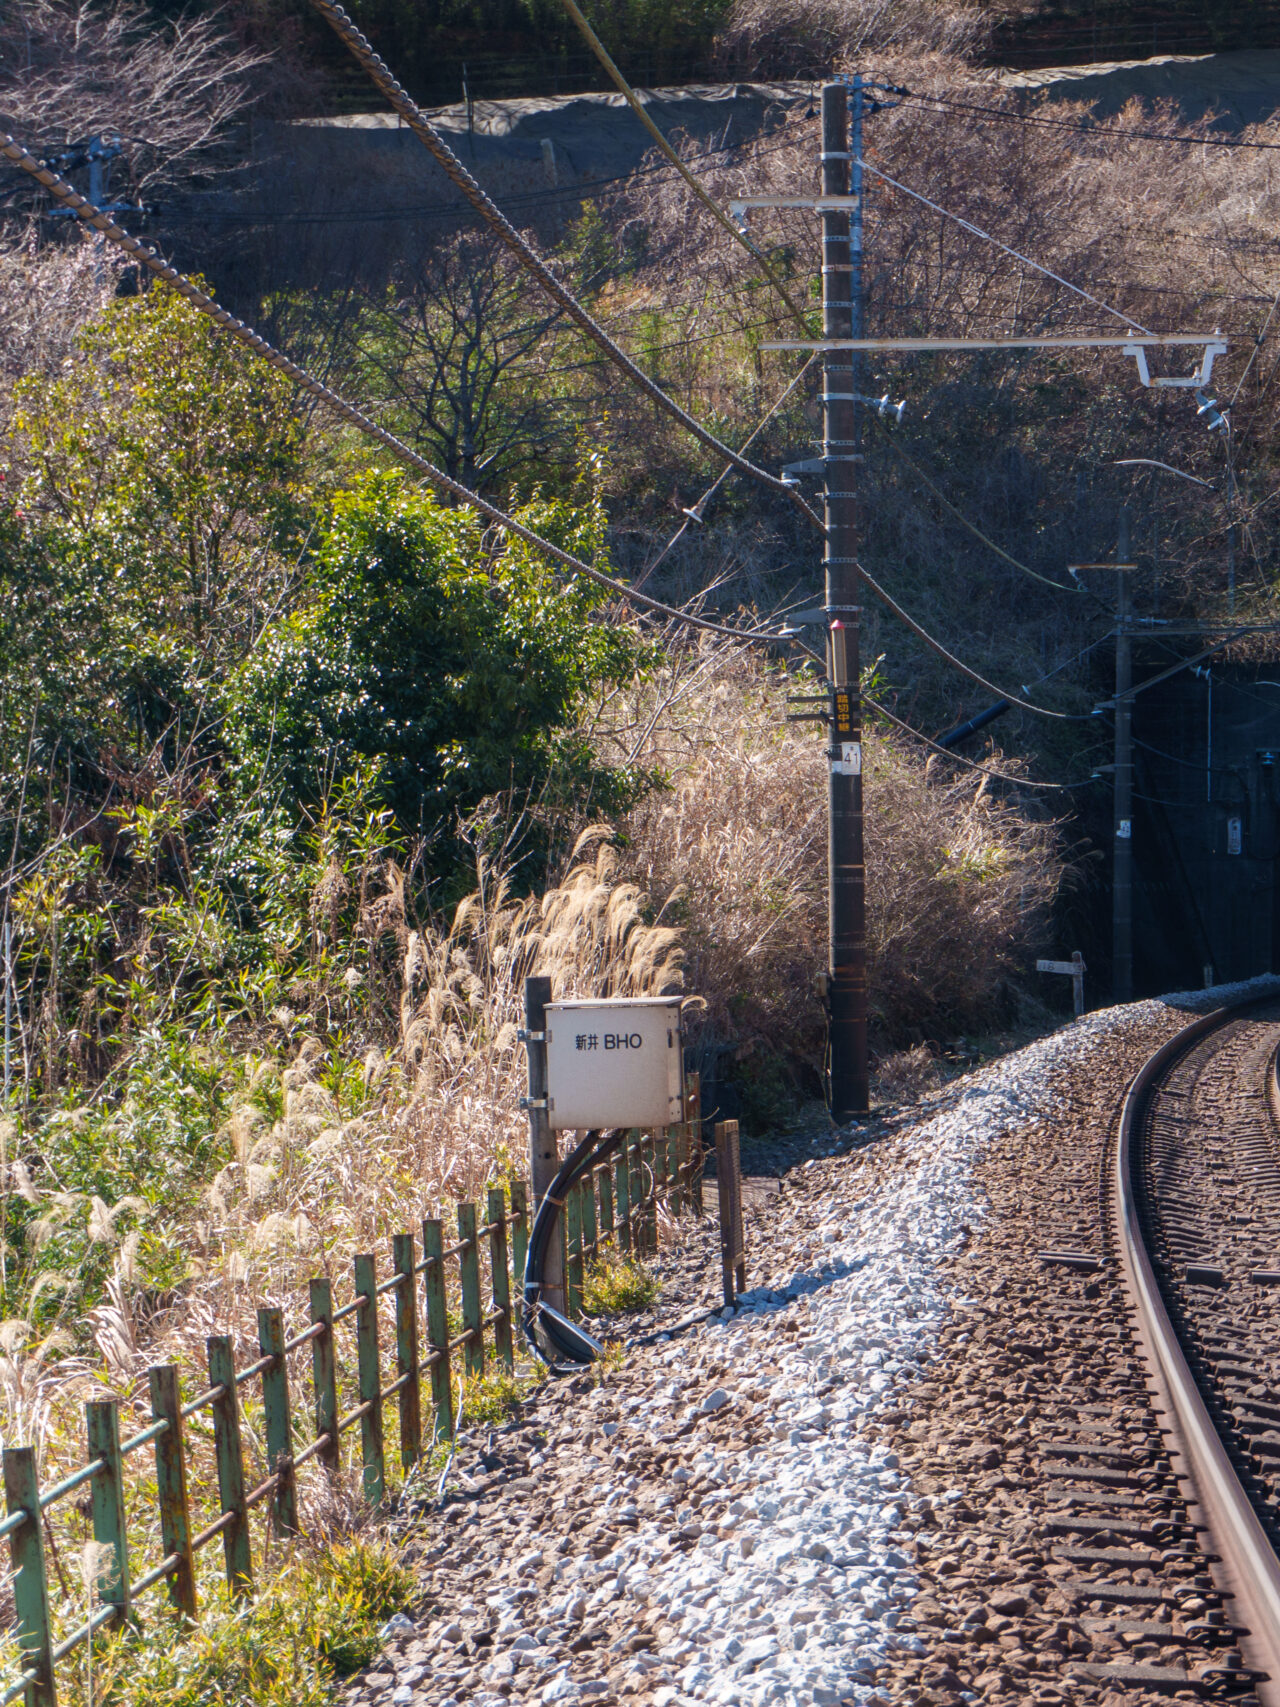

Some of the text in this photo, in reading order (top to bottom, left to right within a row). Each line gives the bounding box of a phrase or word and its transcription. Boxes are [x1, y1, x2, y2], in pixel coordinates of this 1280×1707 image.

[844, 752, 858, 765] 41
[576, 1033, 642, 1050] 新井 BHO
